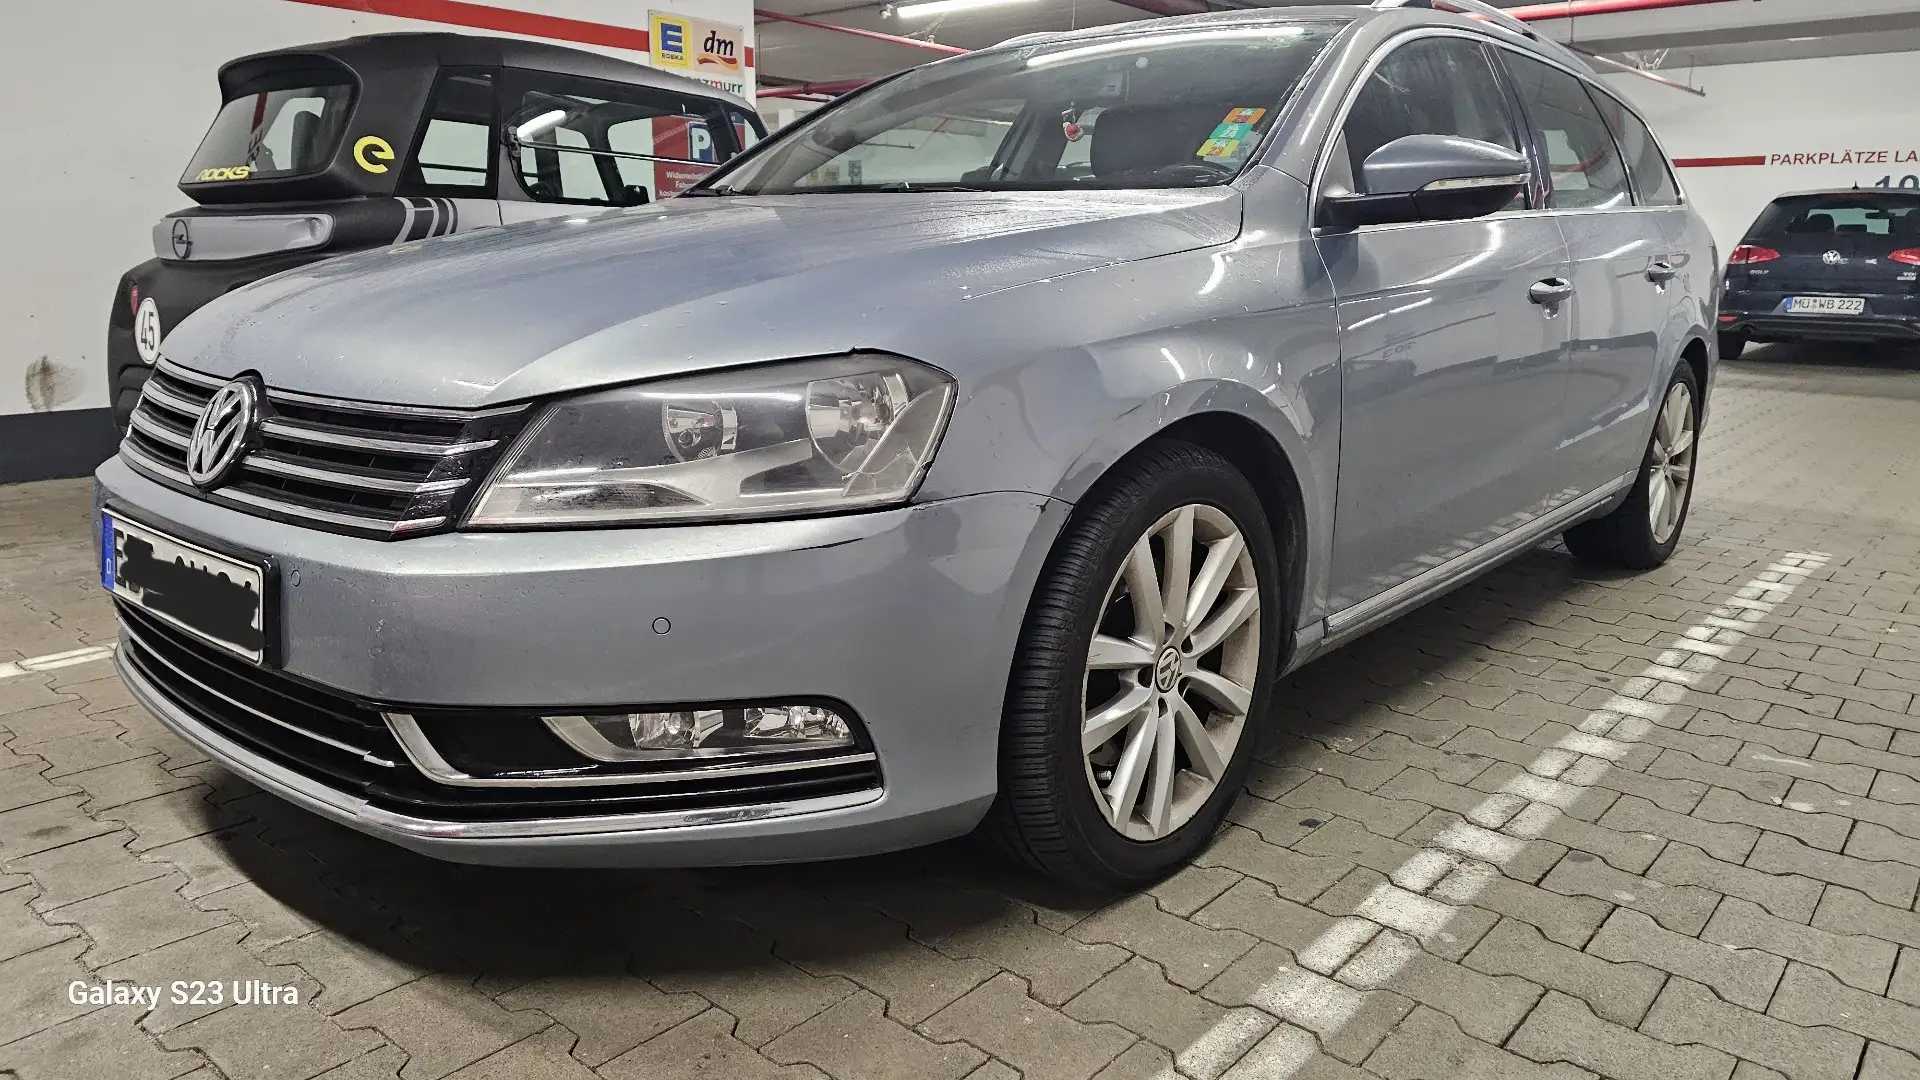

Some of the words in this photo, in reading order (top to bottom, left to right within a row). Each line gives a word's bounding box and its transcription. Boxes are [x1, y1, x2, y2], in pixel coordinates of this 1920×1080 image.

[661, 23, 682, 53] E
[703, 30, 734, 56] dm
[691, 127, 711, 159] P
[1771, 150, 1889, 166] PARKPLÄTZE
[1894, 150, 1920, 163] LA
[1793, 298, 1810, 309] MÜ
[1818, 299, 1835, 309] WB
[1837, 299, 1862, 311] 222
[141, 310, 155, 351] 45
